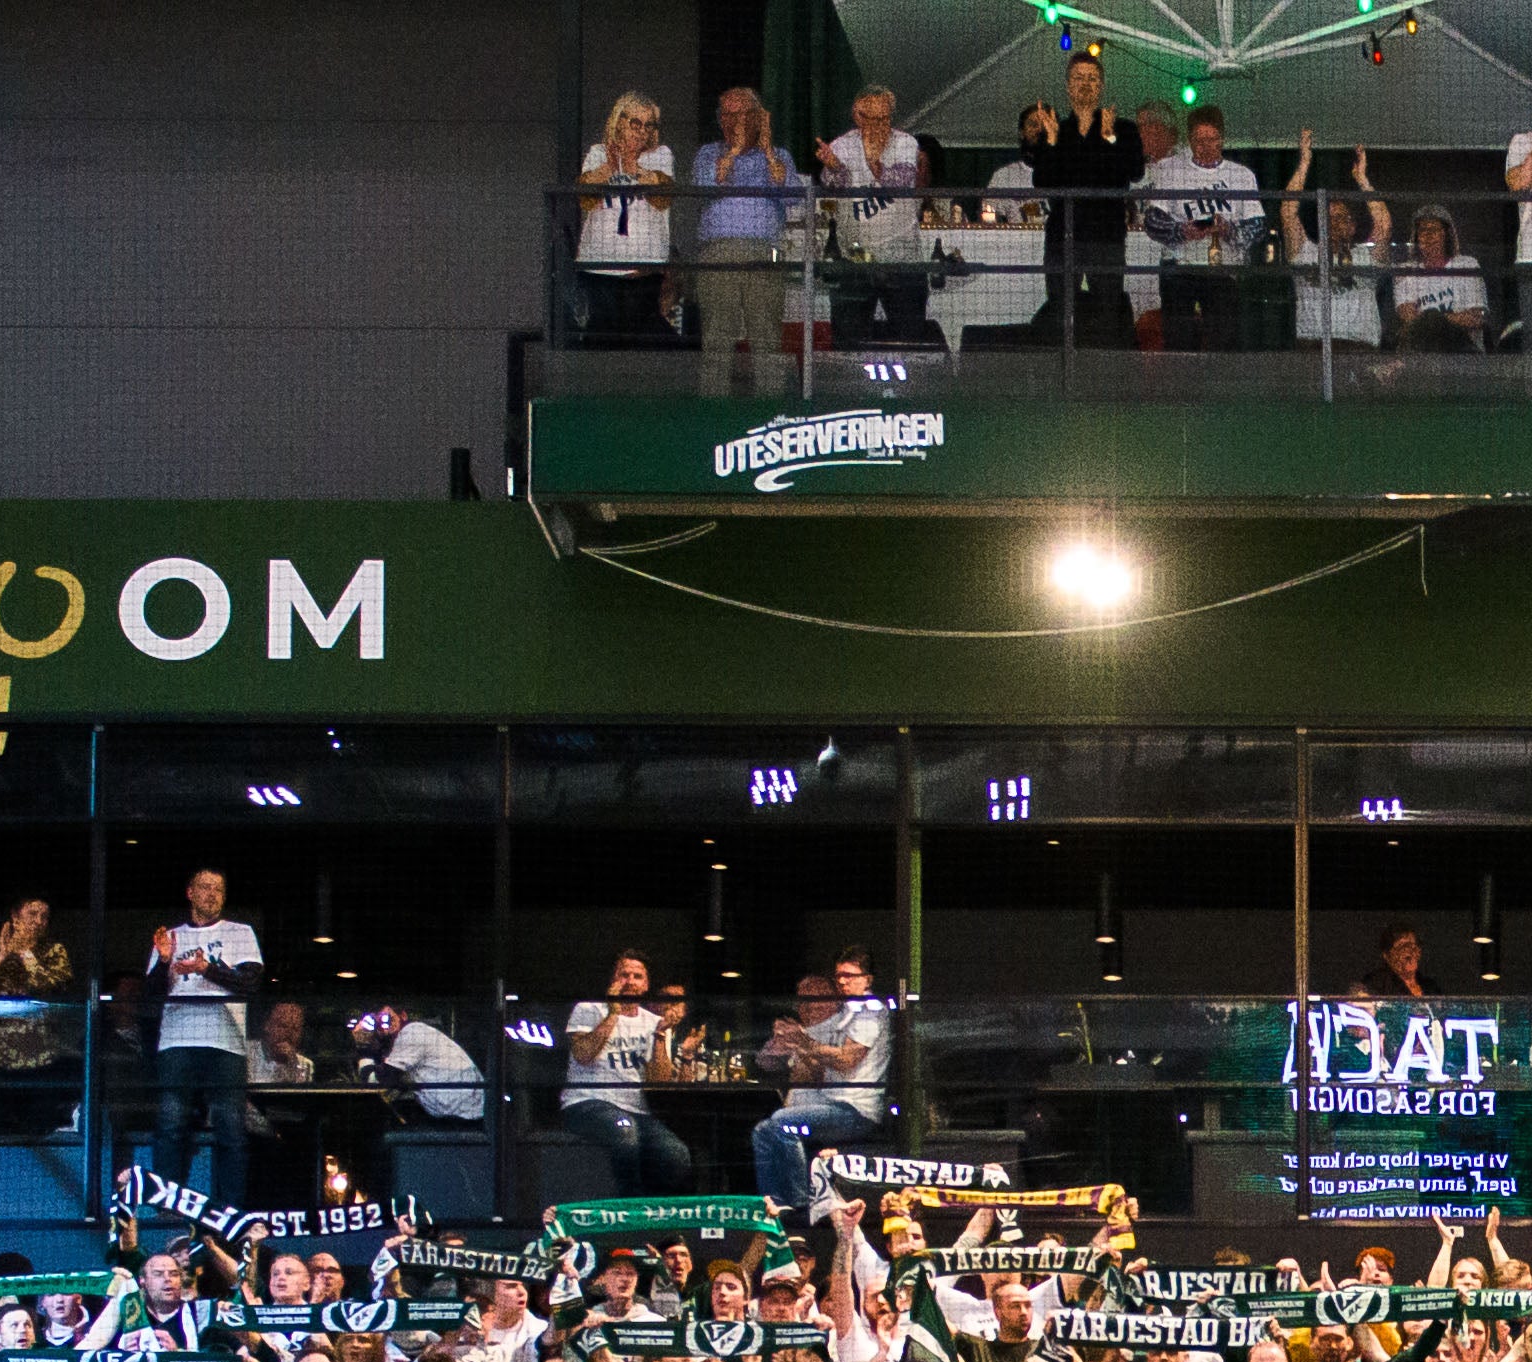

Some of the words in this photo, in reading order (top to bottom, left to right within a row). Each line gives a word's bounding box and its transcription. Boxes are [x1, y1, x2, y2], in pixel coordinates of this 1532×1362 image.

[715, 413, 944, 477] UTESERVERINGEN
[318, 1203, 383, 1236] 1932
[400, 1243, 516, 1277] FÄRJESTAD
[1055, 1316, 1218, 1347] FÄRJESTAD
